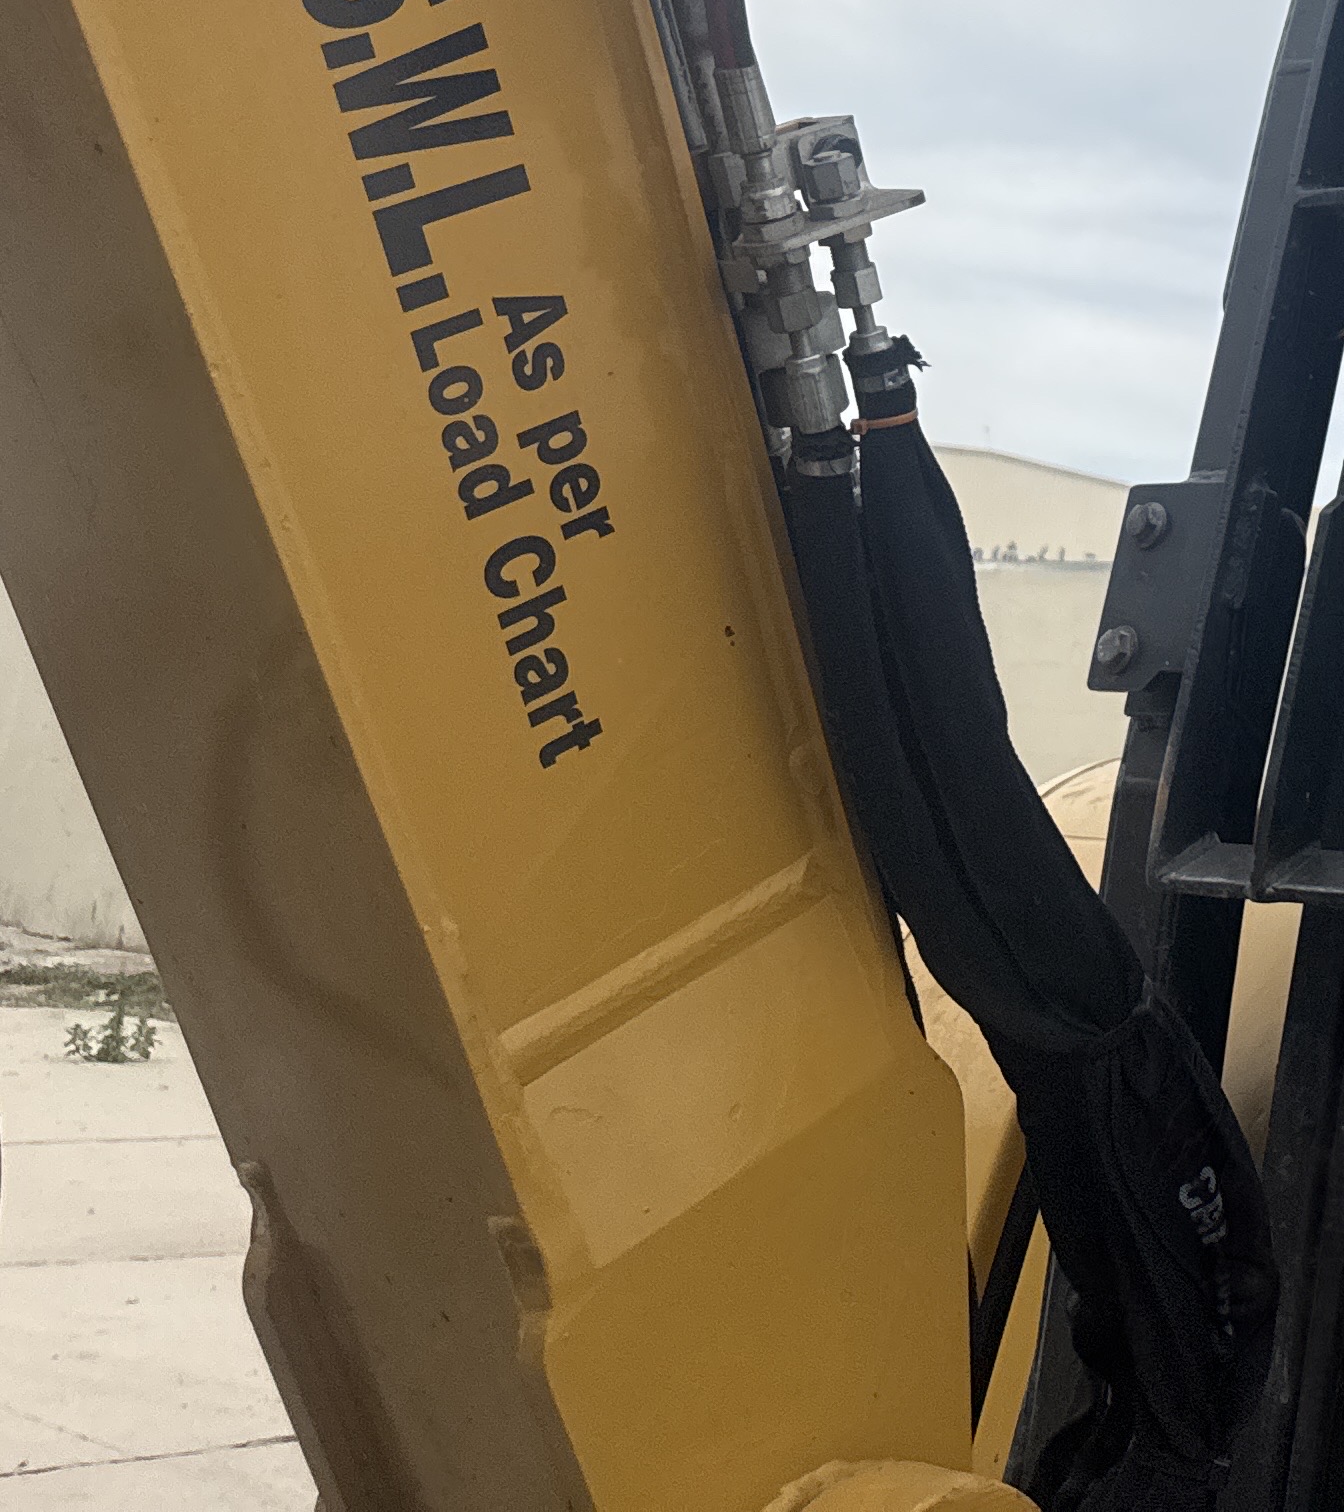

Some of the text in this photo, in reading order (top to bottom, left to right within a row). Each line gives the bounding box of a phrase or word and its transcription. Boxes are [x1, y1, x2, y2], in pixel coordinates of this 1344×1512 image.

[409, 307, 604, 770] Load Chart
[491, 294, 616, 541] As per
